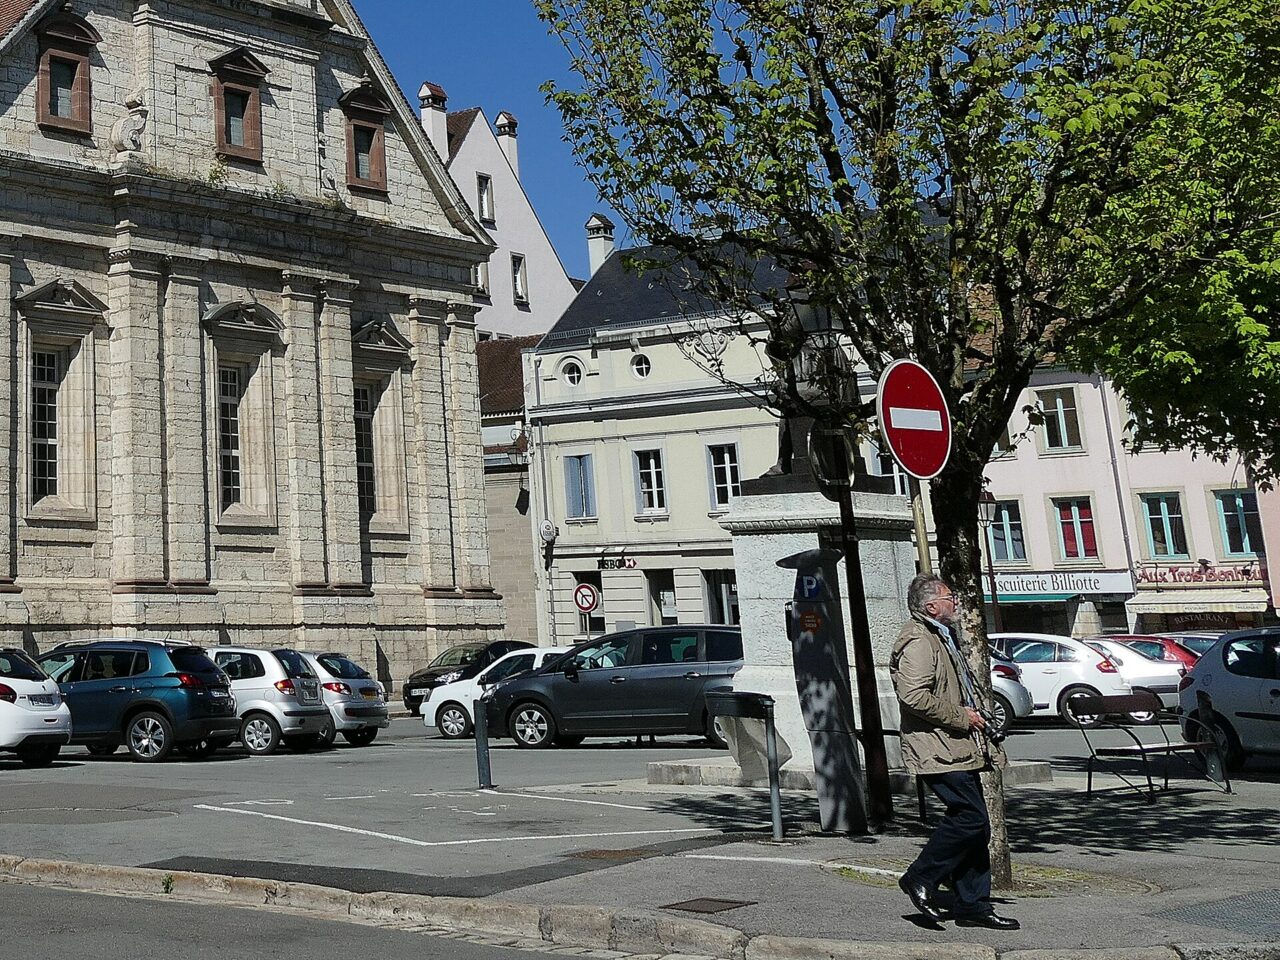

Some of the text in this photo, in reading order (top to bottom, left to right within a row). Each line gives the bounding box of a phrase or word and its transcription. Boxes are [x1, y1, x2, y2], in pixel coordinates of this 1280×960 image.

[803, 575, 817, 598] P
[1050, 573, 1101, 591] Billiotte
[1174, 613, 1231, 624] RESTAURANT
